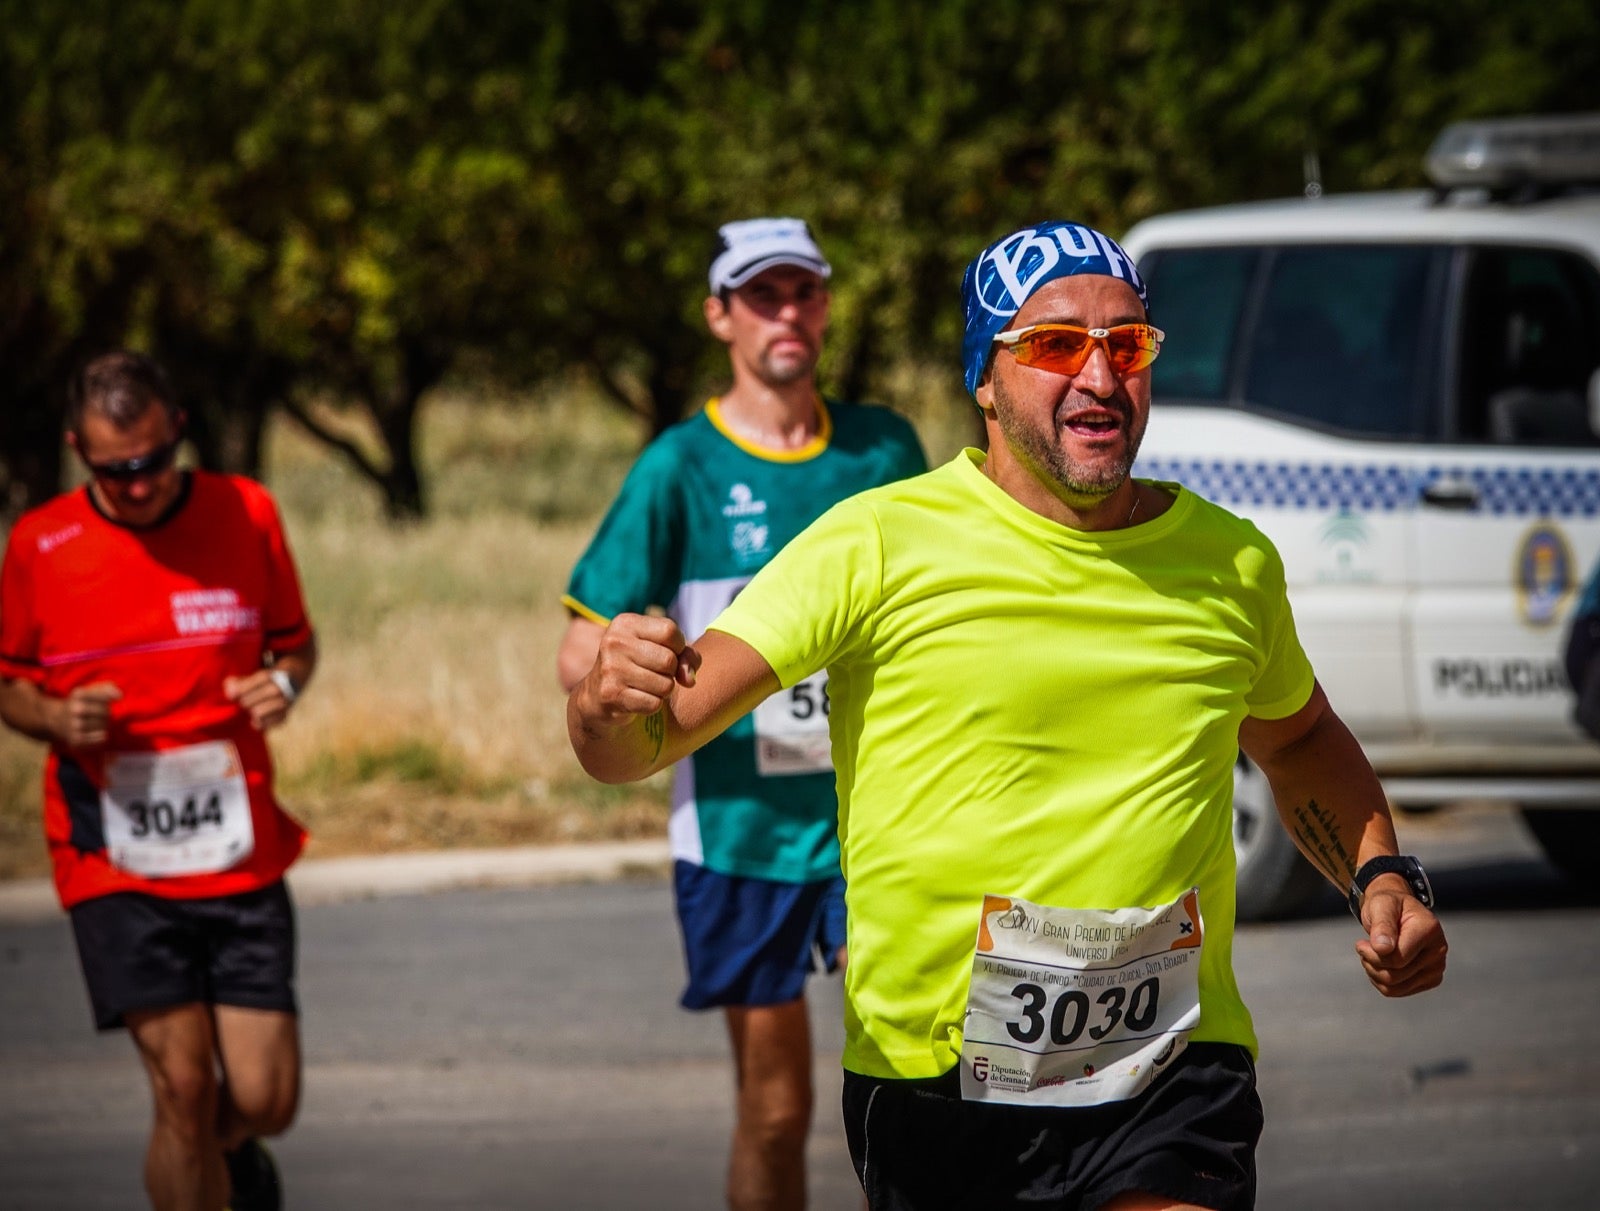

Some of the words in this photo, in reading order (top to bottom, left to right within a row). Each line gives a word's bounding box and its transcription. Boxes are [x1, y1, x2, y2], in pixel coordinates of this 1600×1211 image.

[128, 791, 223, 838] 3044
[1012, 912, 1040, 934] XXXV
[1043, 921, 1070, 940] GRAN
[1074, 924, 1111, 942] PREMIO
[1114, 926, 1127, 942] DE
[1065, 943, 1107, 960] UNIVERSO
[984, 961, 995, 974] XL
[997, 964, 1028, 979] PRUEBA
[1030, 970, 1041, 981] DE
[1044, 971, 1070, 987] FONDO
[1106, 975, 1118, 986] DE
[1006, 977, 1160, 1046] 3030
[990, 1073, 999, 1082] de
[991, 1064, 1031, 1078] Diputación
